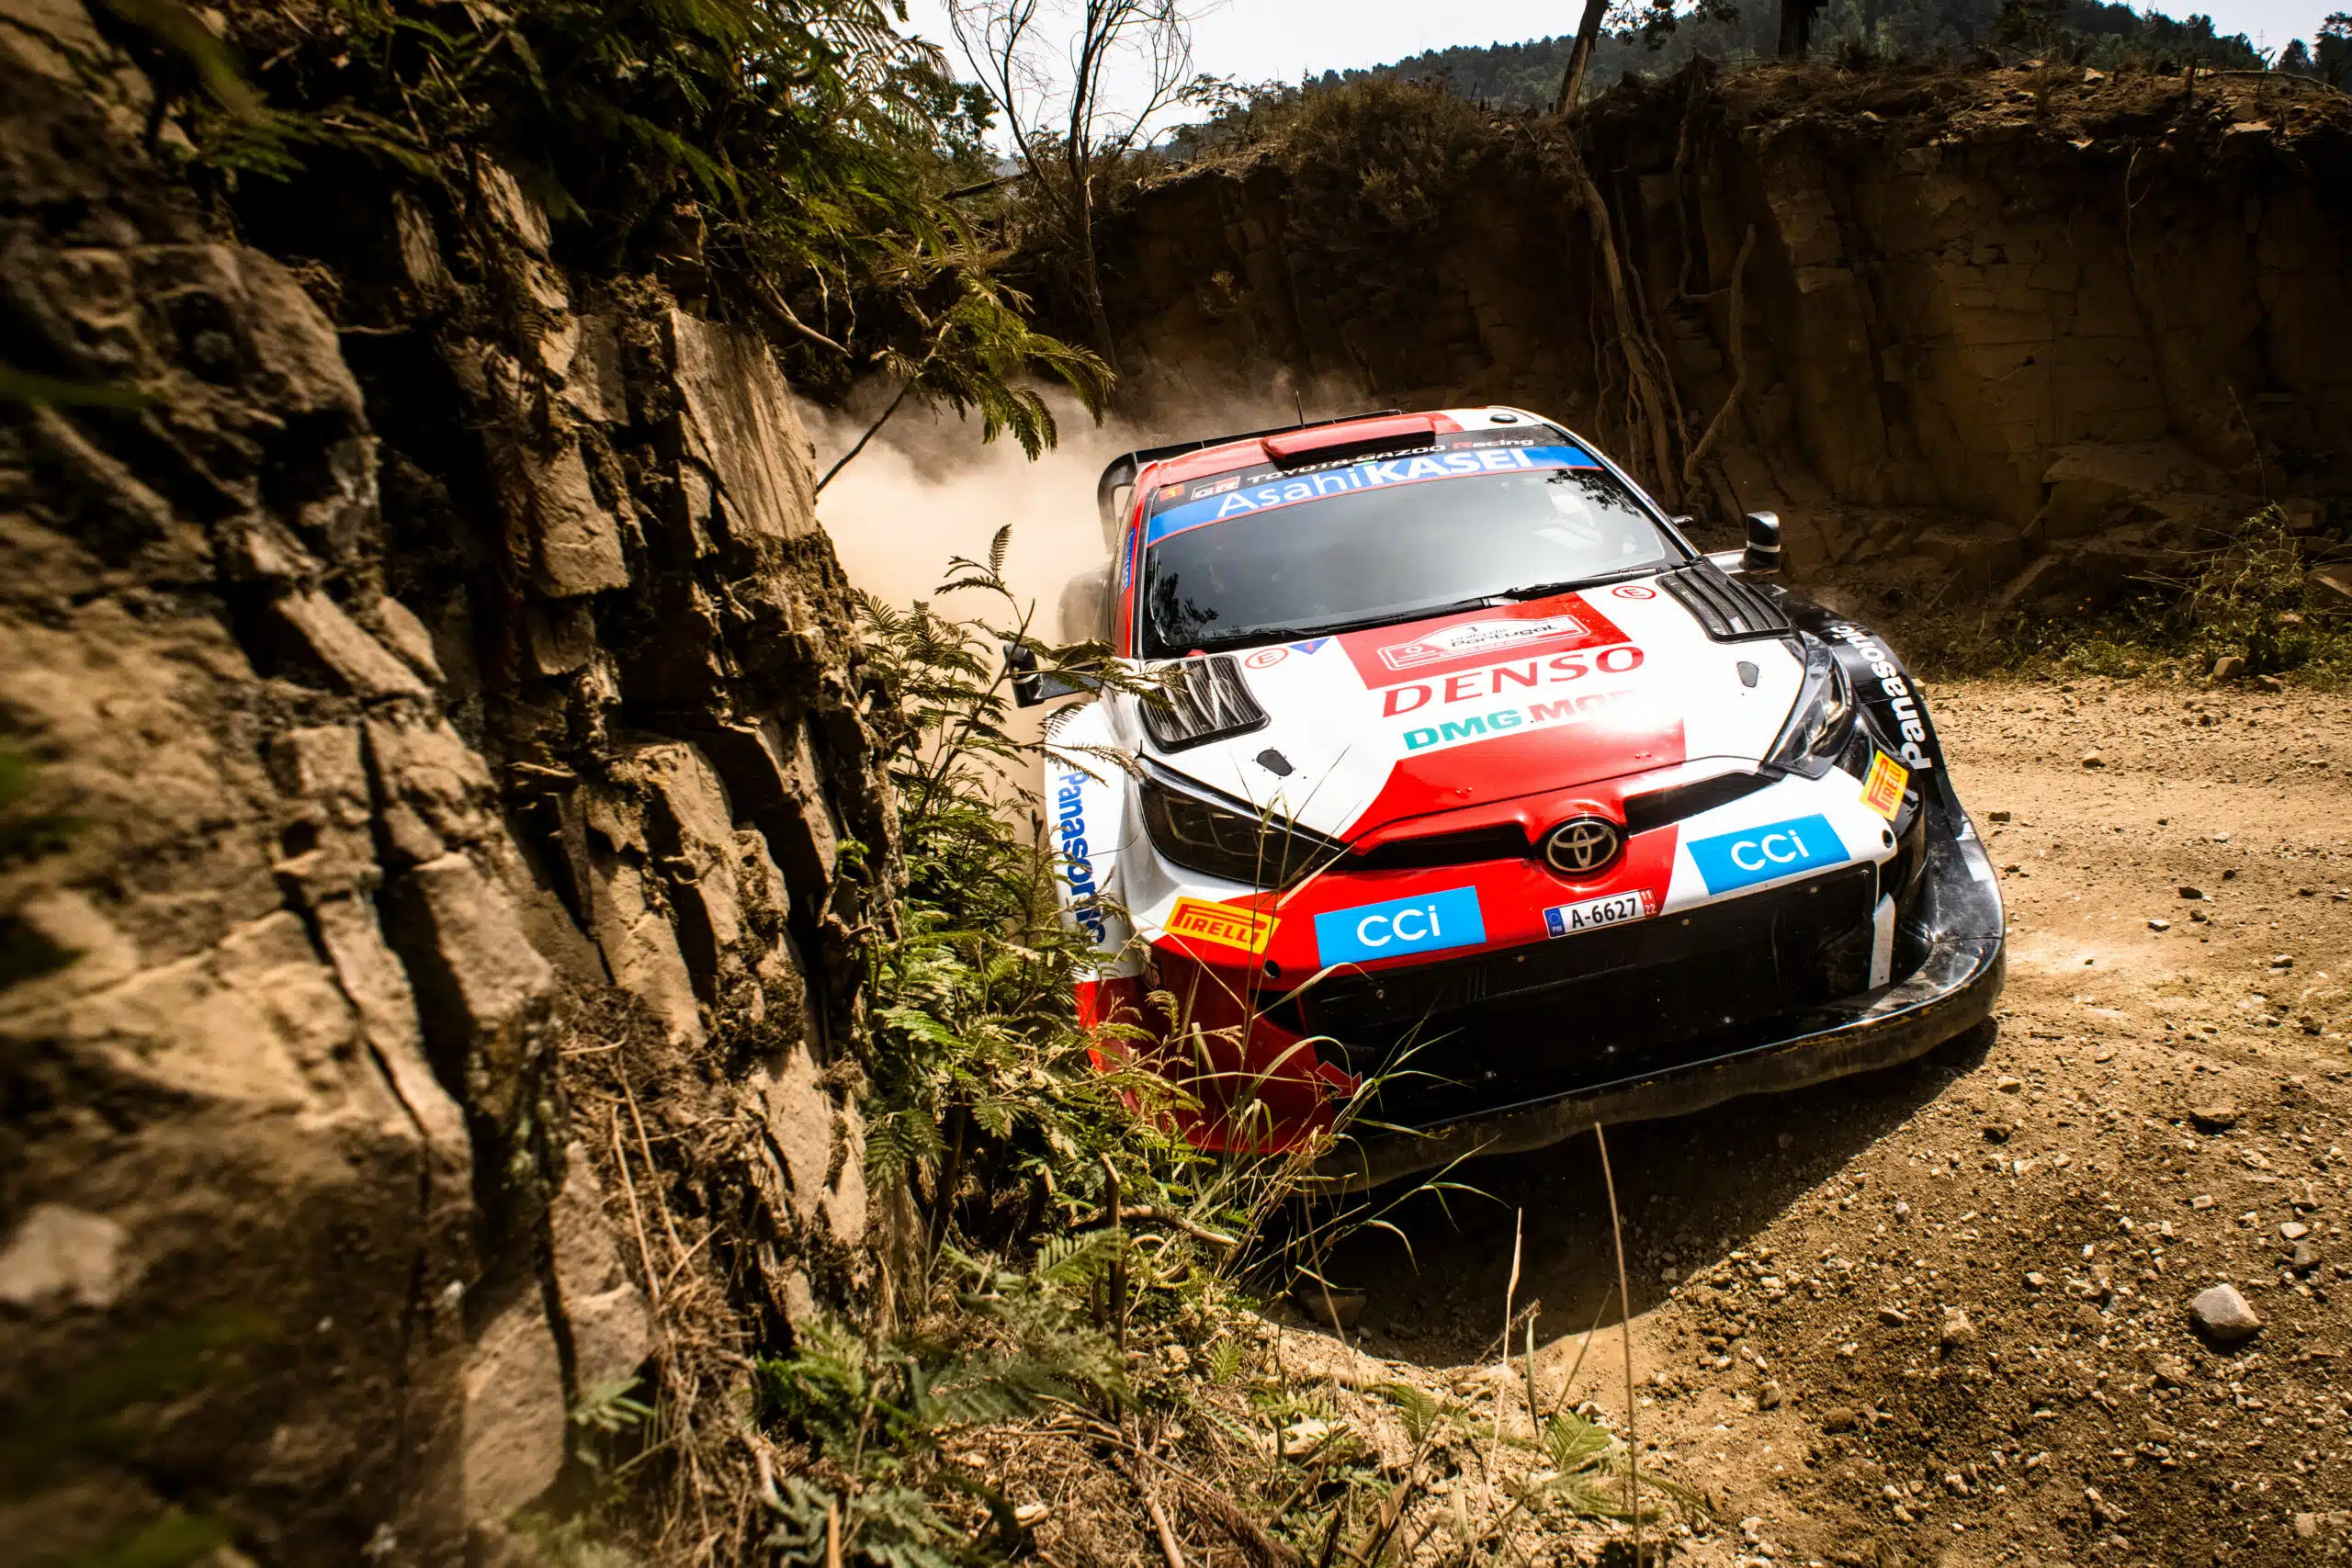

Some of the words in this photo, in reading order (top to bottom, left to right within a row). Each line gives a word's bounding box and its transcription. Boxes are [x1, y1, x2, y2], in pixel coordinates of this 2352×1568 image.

[1216, 447, 1533, 519] AsahiKASEI
[1247, 458, 1348, 484] TOYOTA
[1356, 445, 1446, 462] GAZOO
[1452, 439, 1534, 450] Racing
[1382, 646, 1645, 717] DENSO
[1829, 622, 1932, 770] Panasonic
[1867, 758, 1903, 812] PIRELLI
[1171, 904, 1267, 945] PIRELLI
[1552, 925, 1563, 933] FIN
[1571, 897, 1636, 929] A-6627
[1640, 890, 1652, 901] 11
[1645, 903, 1657, 915] 22
